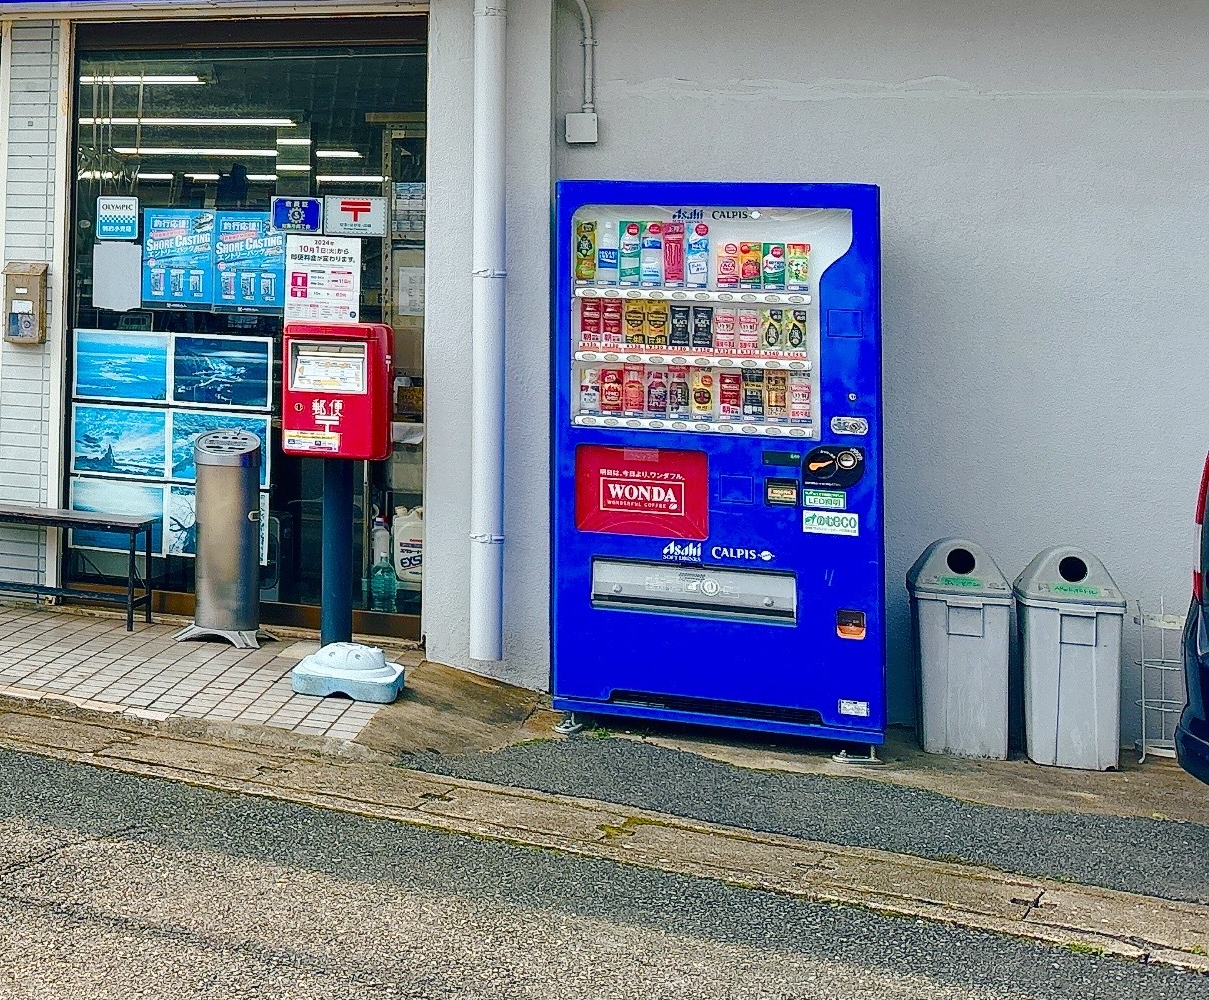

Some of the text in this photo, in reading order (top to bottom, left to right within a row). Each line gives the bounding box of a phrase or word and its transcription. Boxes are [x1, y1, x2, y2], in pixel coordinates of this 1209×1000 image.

[101, 203, 134, 211] OLYMPIC
[672, 208, 749, 220] Asahi CALPIS
[146, 238, 175, 251] SHORE
[175, 233, 211, 248] CASTING
[215, 241, 245, 255] SHORE
[245, 237, 283, 251] CASTING
[311, 398, 344, 417] 郵便
[607, 483, 678, 503] WONDA
[606, 499, 642, 507] WONDERFUL
[662, 540, 757, 560] Asahi CALPIS
